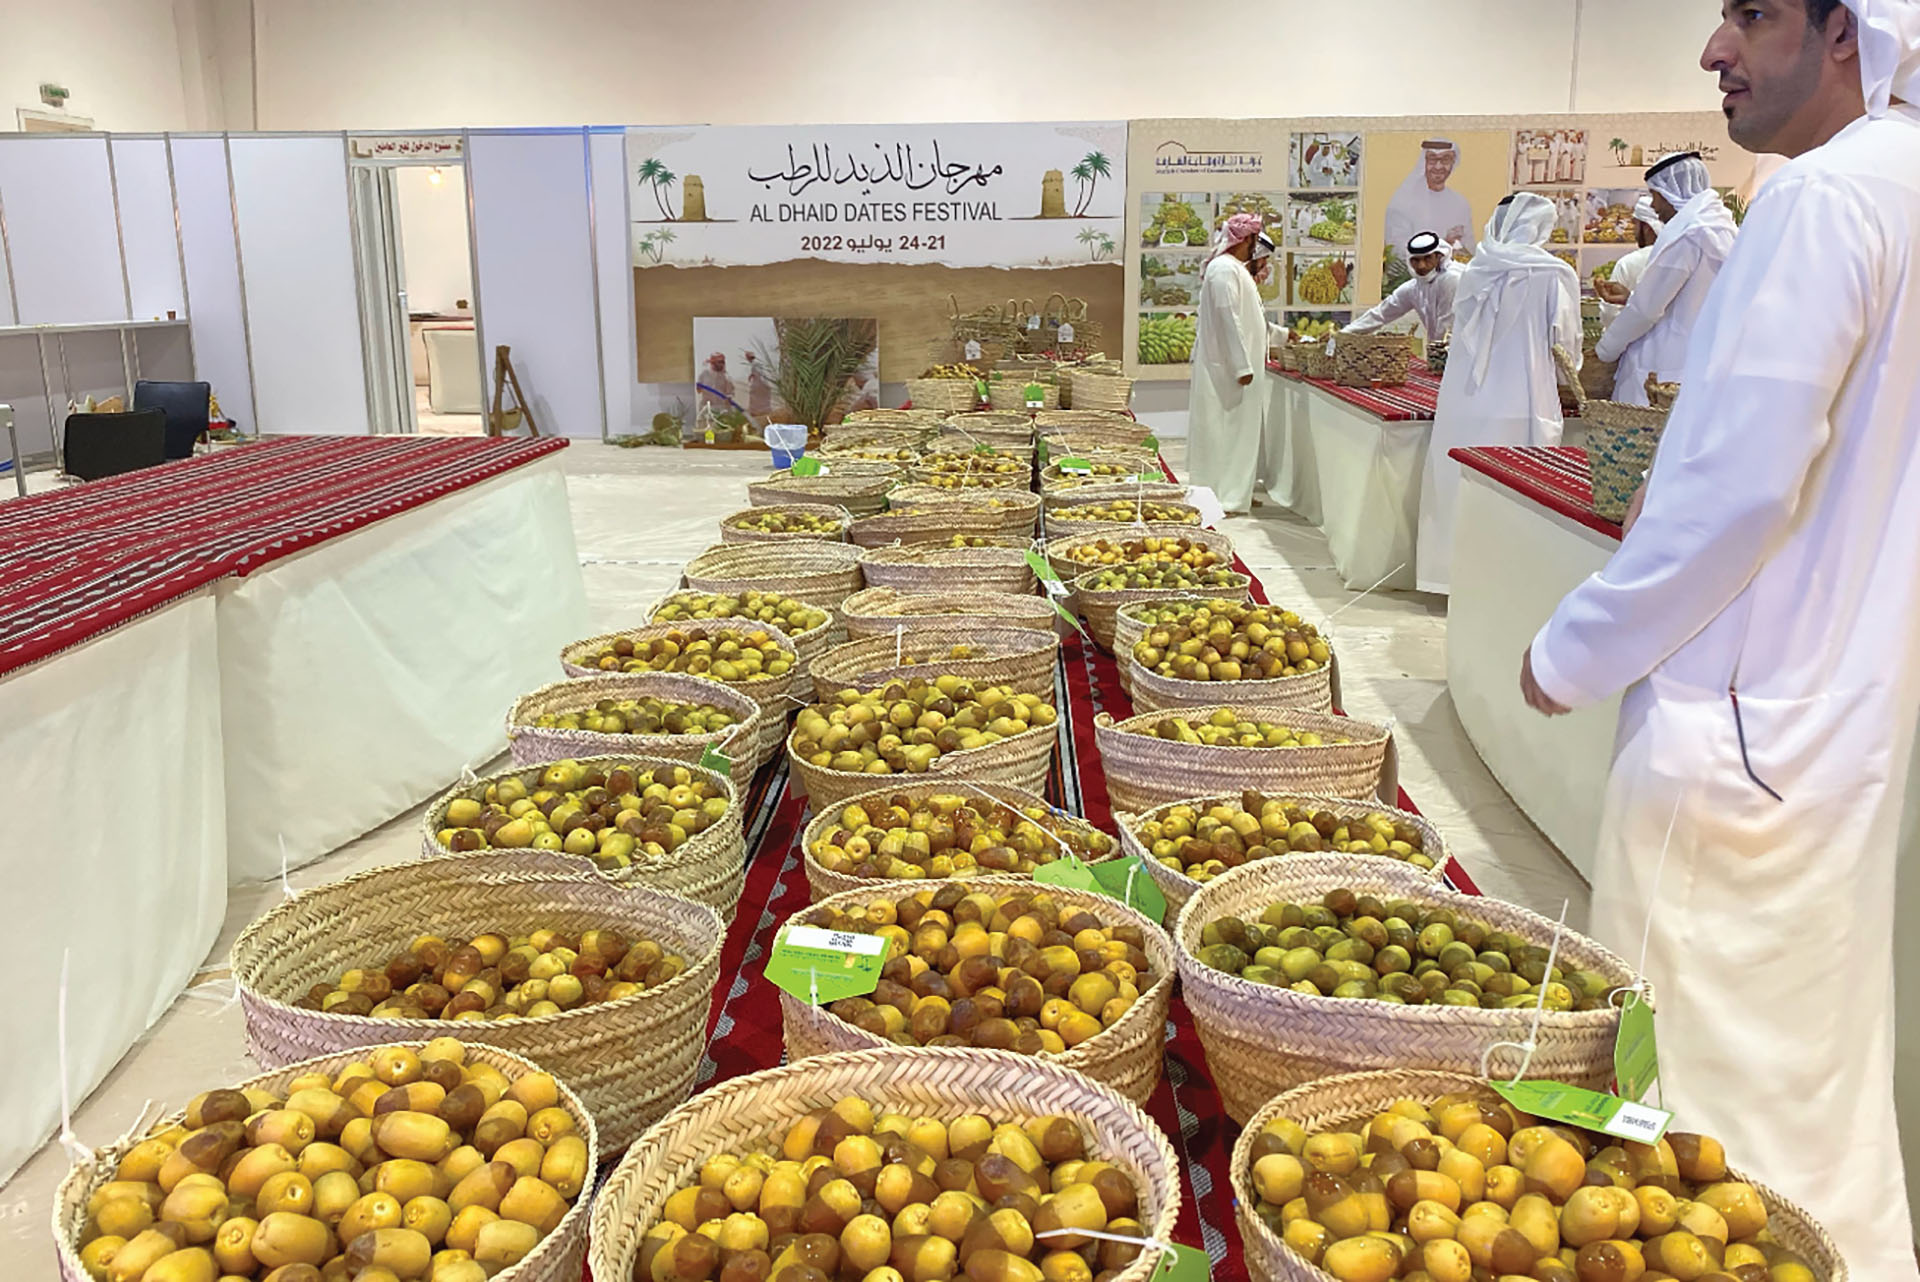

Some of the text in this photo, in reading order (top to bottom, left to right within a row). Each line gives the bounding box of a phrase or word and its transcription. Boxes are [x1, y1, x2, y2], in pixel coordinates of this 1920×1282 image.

[747, 139, 1003, 196] مهرجان الذيد للرطب
[750, 202, 1003, 222] AL DHAID DATES FESTIVAL
[800, 236, 843, 251] 2022
[846, 234, 893, 253] يوليو
